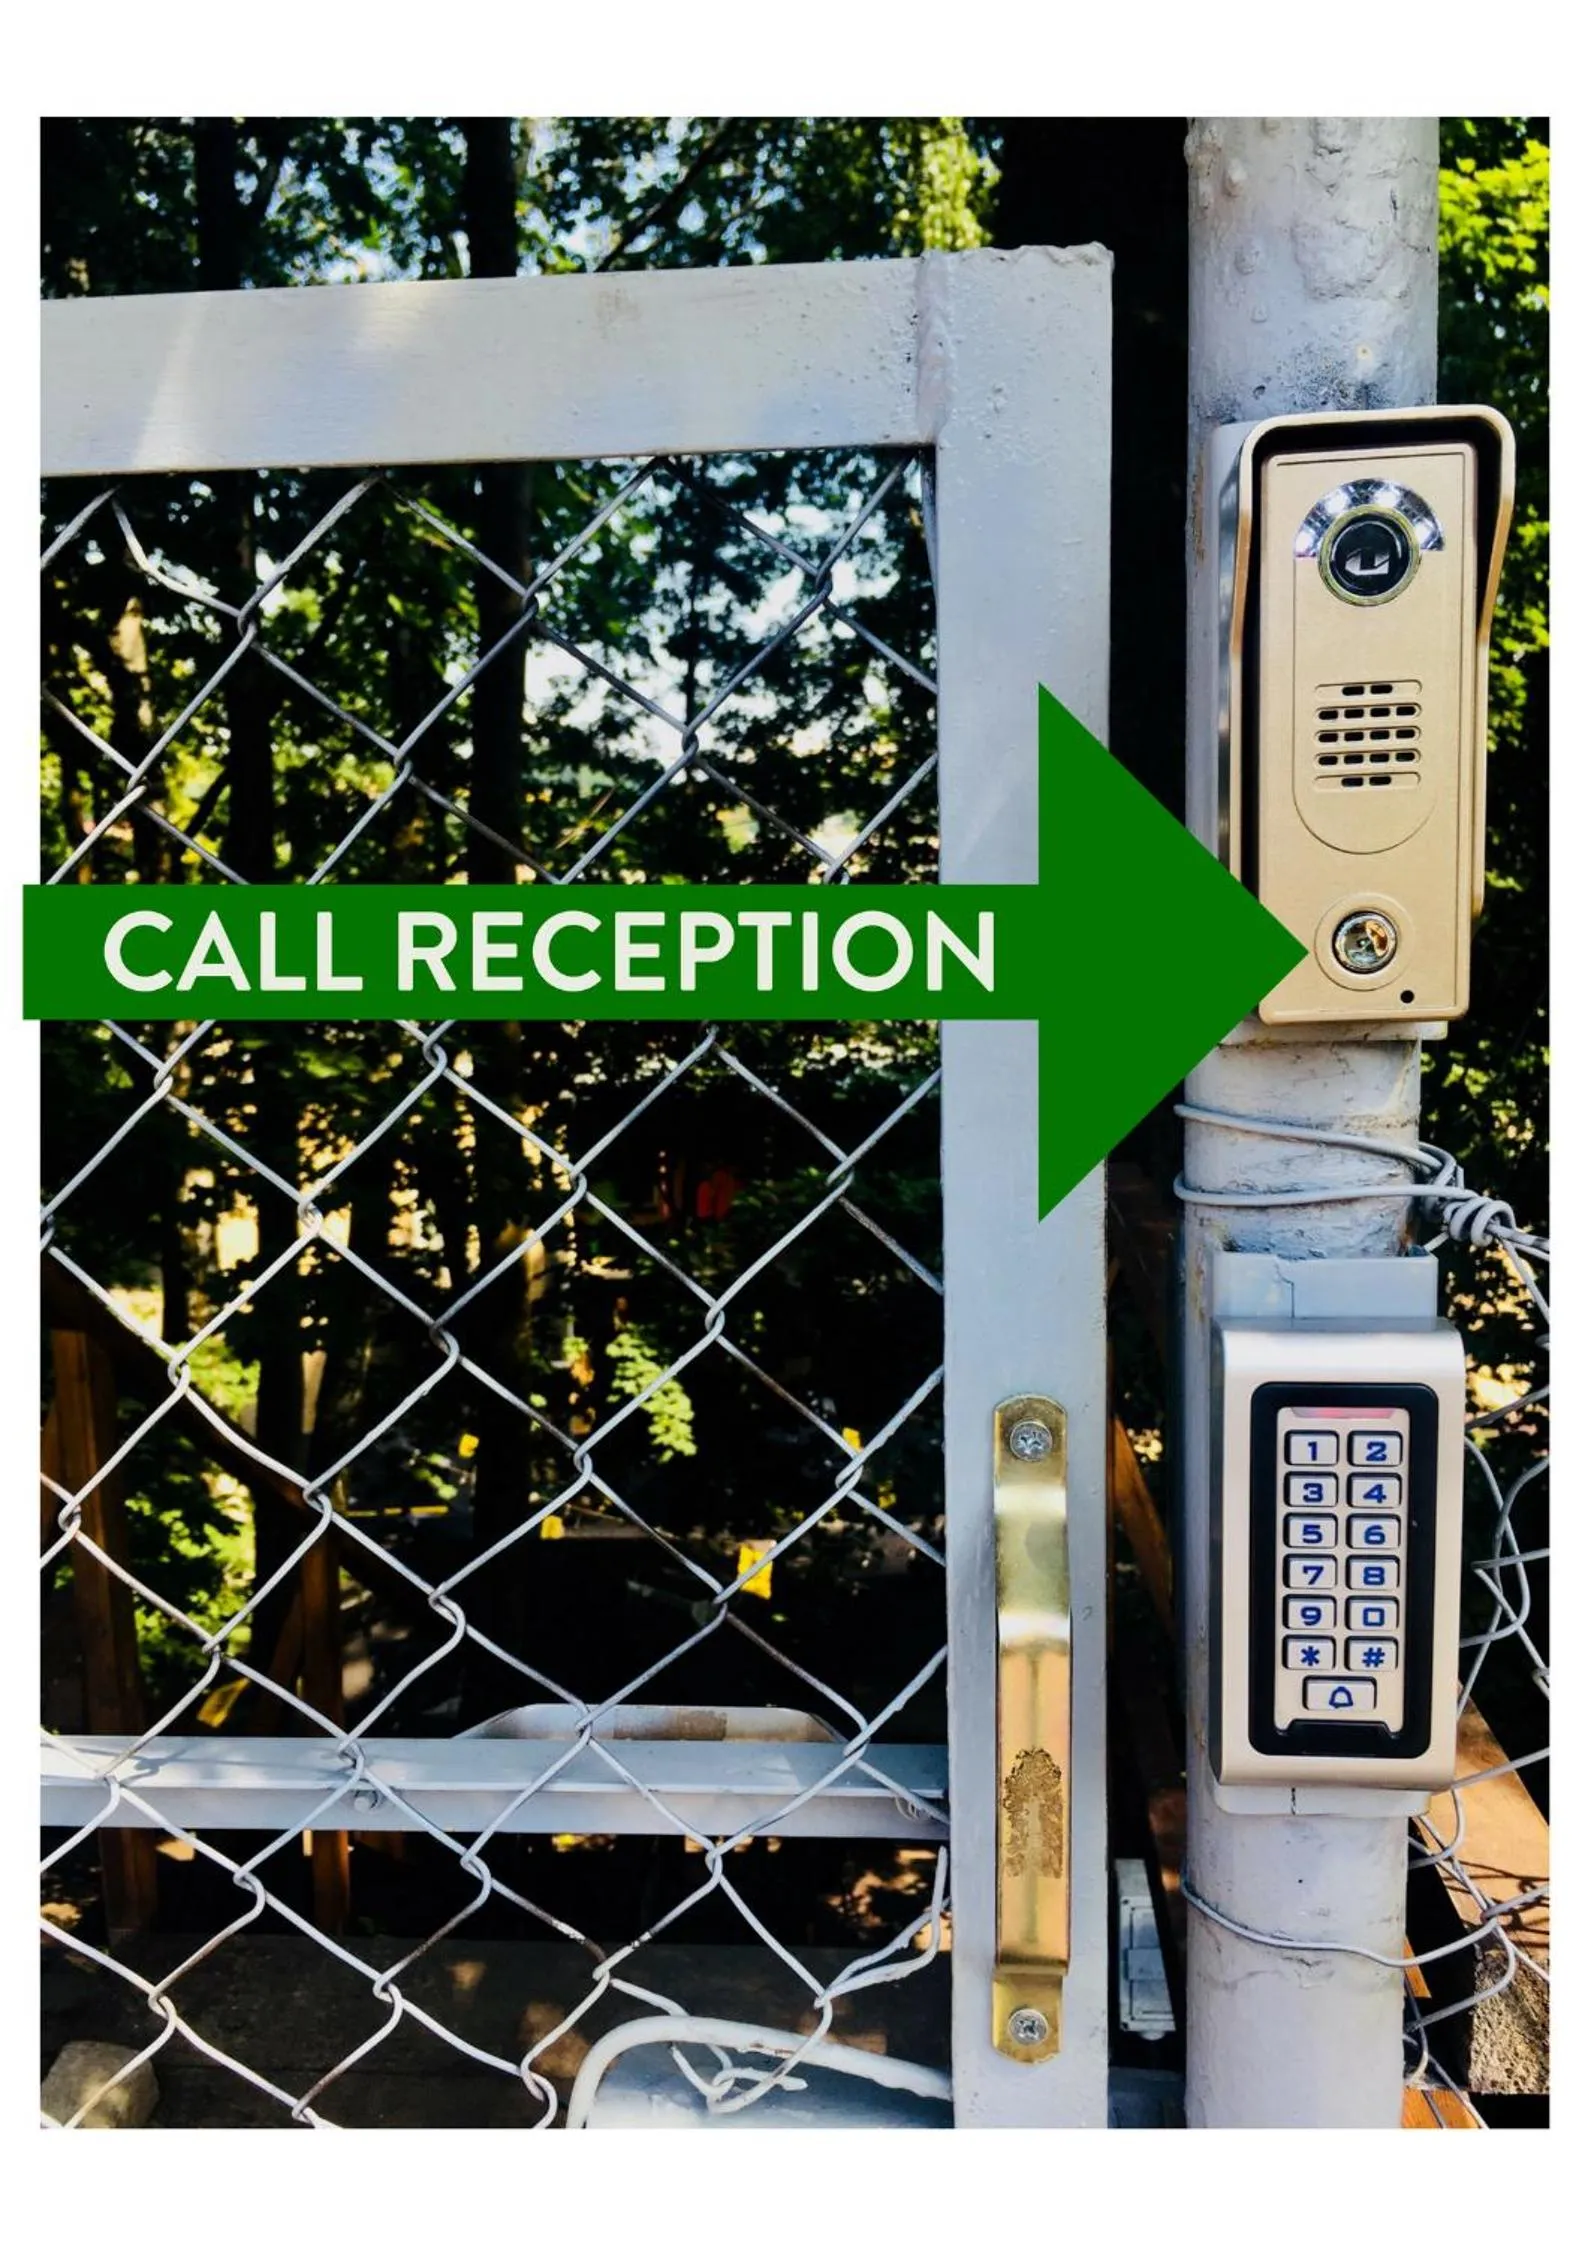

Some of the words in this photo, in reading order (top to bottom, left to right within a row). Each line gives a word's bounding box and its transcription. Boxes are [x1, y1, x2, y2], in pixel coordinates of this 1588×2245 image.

[1307, 1441, 1319, 1462] 1
[1365, 1440, 1388, 1463] 2
[1302, 1482, 1324, 1503] 3
[1363, 1483, 1387, 1504] 4
[1302, 1523, 1324, 1544] 5
[1363, 1524, 1386, 1545] 6
[1302, 1565, 1324, 1585] 7
[1362, 1565, 1386, 1586] 8
[1300, 1605, 1322, 1627] 9
[1362, 1606, 1386, 1627] 0
